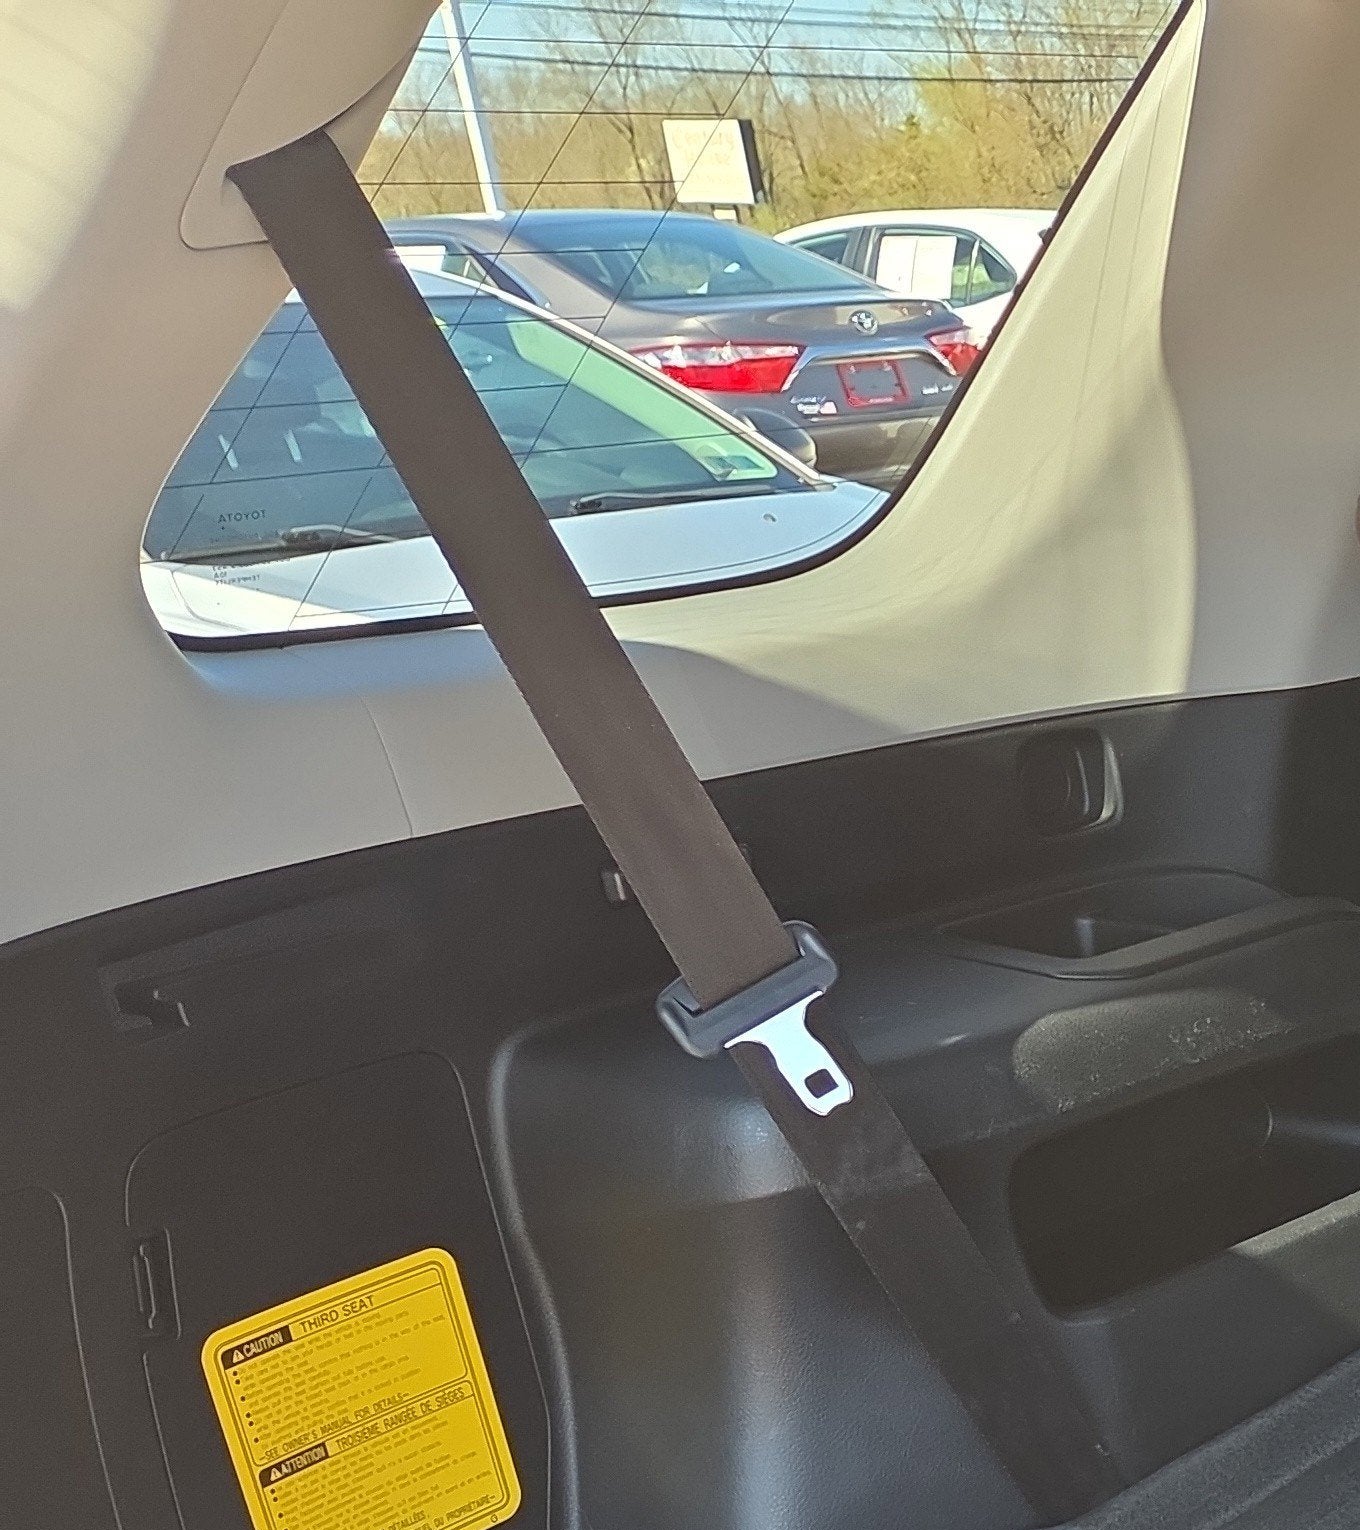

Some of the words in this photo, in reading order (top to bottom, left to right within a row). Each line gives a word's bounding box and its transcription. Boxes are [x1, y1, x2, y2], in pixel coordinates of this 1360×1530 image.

[241, 1330, 283, 1358] CAUTION
[298, 1307, 340, 1335] THIRD
[339, 1293, 376, 1318] SEAT
[279, 1444, 326, 1477] ATTENTION
